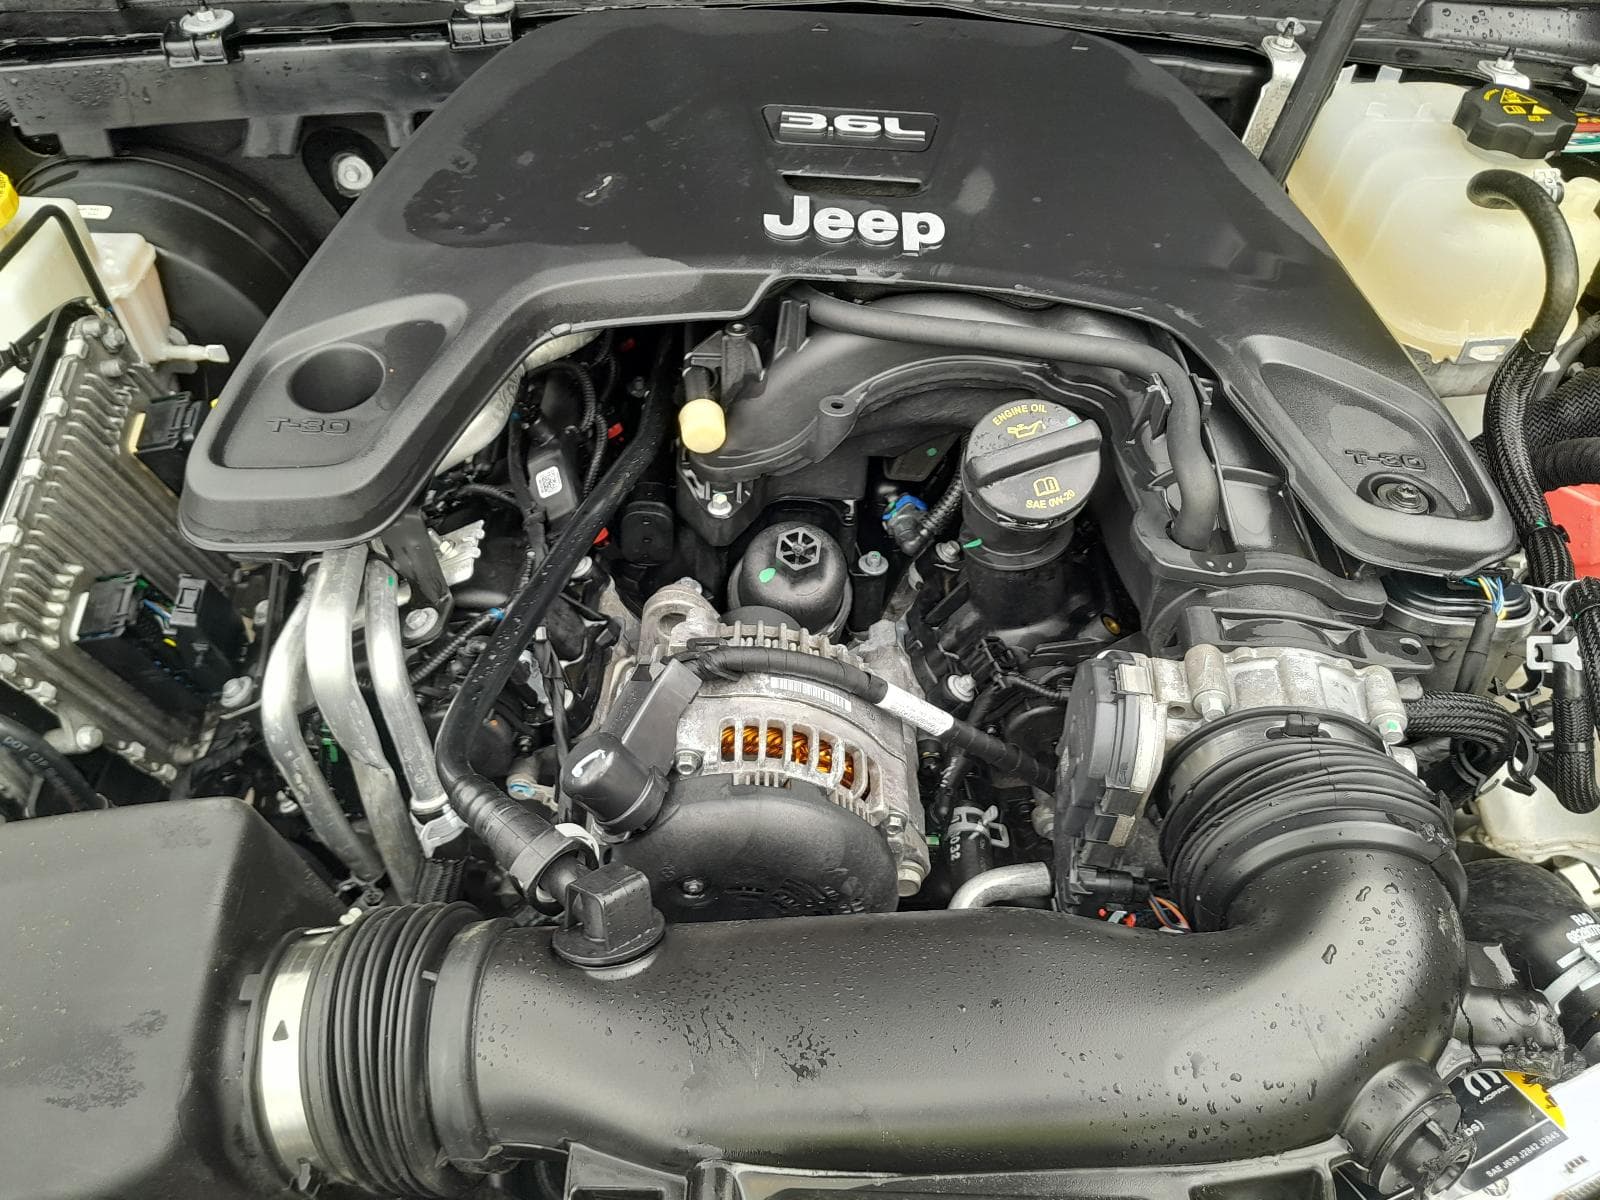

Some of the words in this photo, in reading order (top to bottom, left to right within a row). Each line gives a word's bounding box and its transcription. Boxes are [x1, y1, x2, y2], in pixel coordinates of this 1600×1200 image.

[779, 111, 926, 141] 3.6L
[763, 195, 946, 257] Jeep
[992, 404, 1029, 426] ENGINE
[1030, 403, 1048, 414] OIL
[266, 418, 350, 435] T-30
[1344, 450, 1427, 472] T-30
[1025, 499, 1047, 509] SAE
[1048, 489, 1076, 507] 0W-20
[1486, 1164, 1504, 1178] SAE
